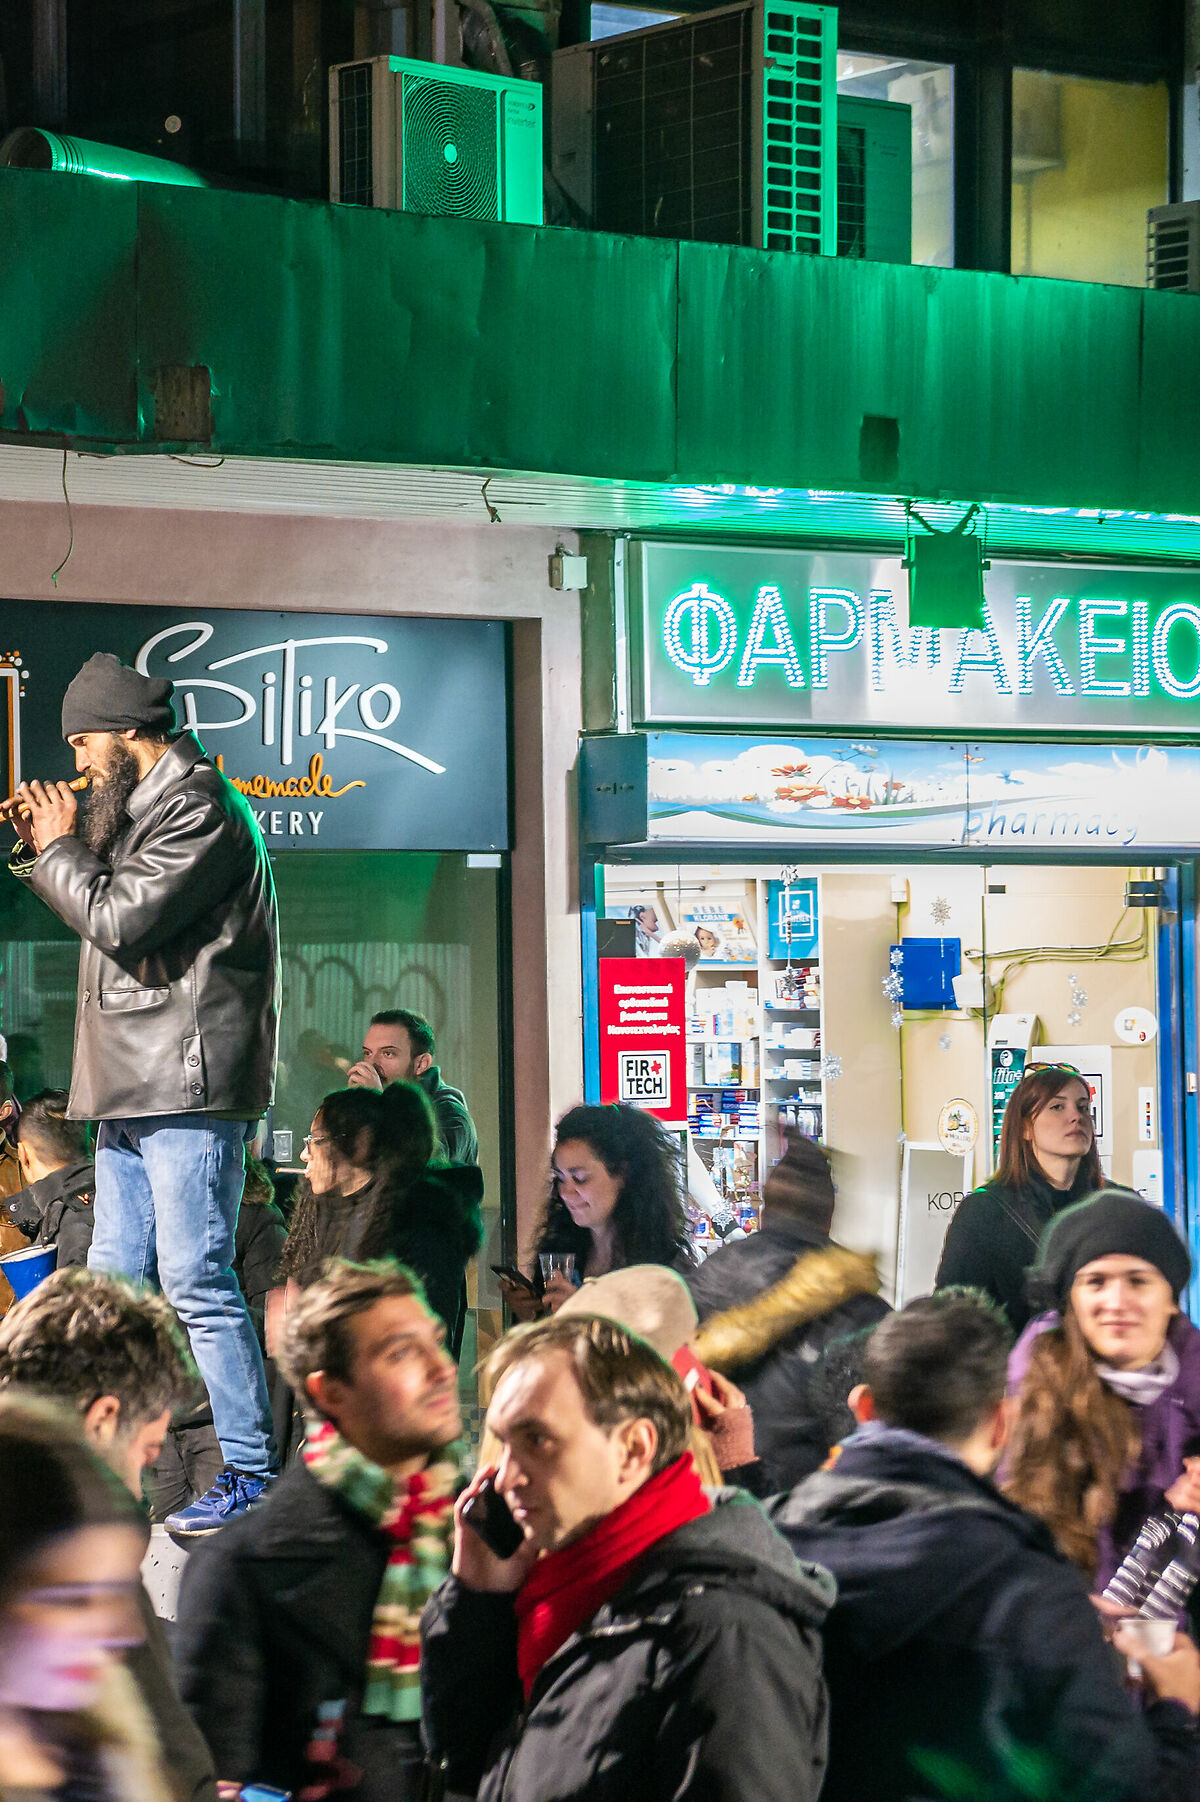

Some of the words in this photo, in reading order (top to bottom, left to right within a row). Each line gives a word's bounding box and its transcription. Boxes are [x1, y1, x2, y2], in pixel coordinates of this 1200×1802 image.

[960, 800, 1140, 846] pharmacy
[626, 1060, 650, 1076] FIR
[626, 1078, 662, 1094] TECH
